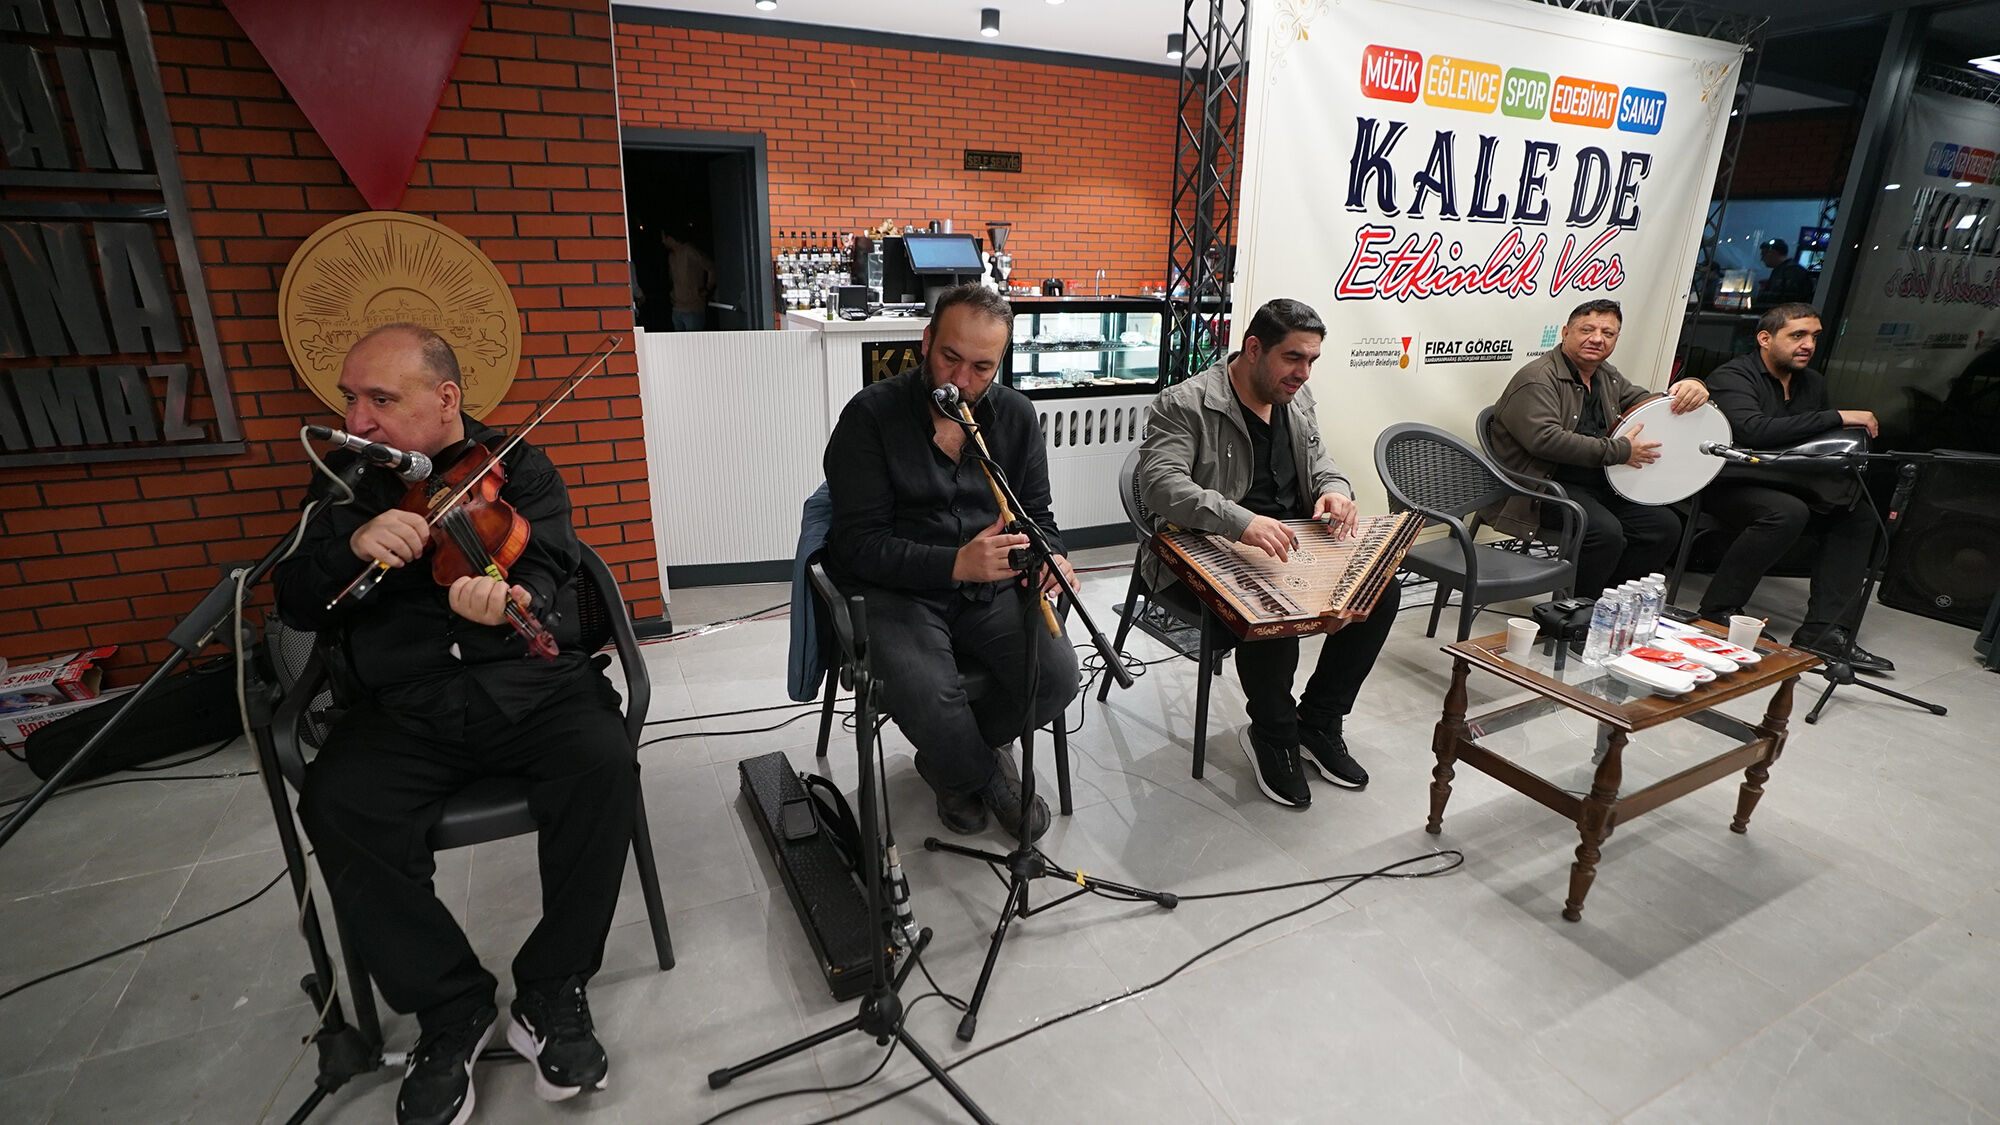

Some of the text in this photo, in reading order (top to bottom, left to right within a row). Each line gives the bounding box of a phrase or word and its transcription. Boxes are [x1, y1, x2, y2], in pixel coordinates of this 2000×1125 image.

[1365, 51, 1664, 126] MÜZİK EĞLENCE SPOR EDEBİYAT SANAT
[1345, 116, 1653, 230] KALE DE
[1335, 223, 1625, 301] Etkinlik Var
[1425, 338, 1514, 355] FIRAT GÖRGEL
[17, 719, 54, 738] BOO
